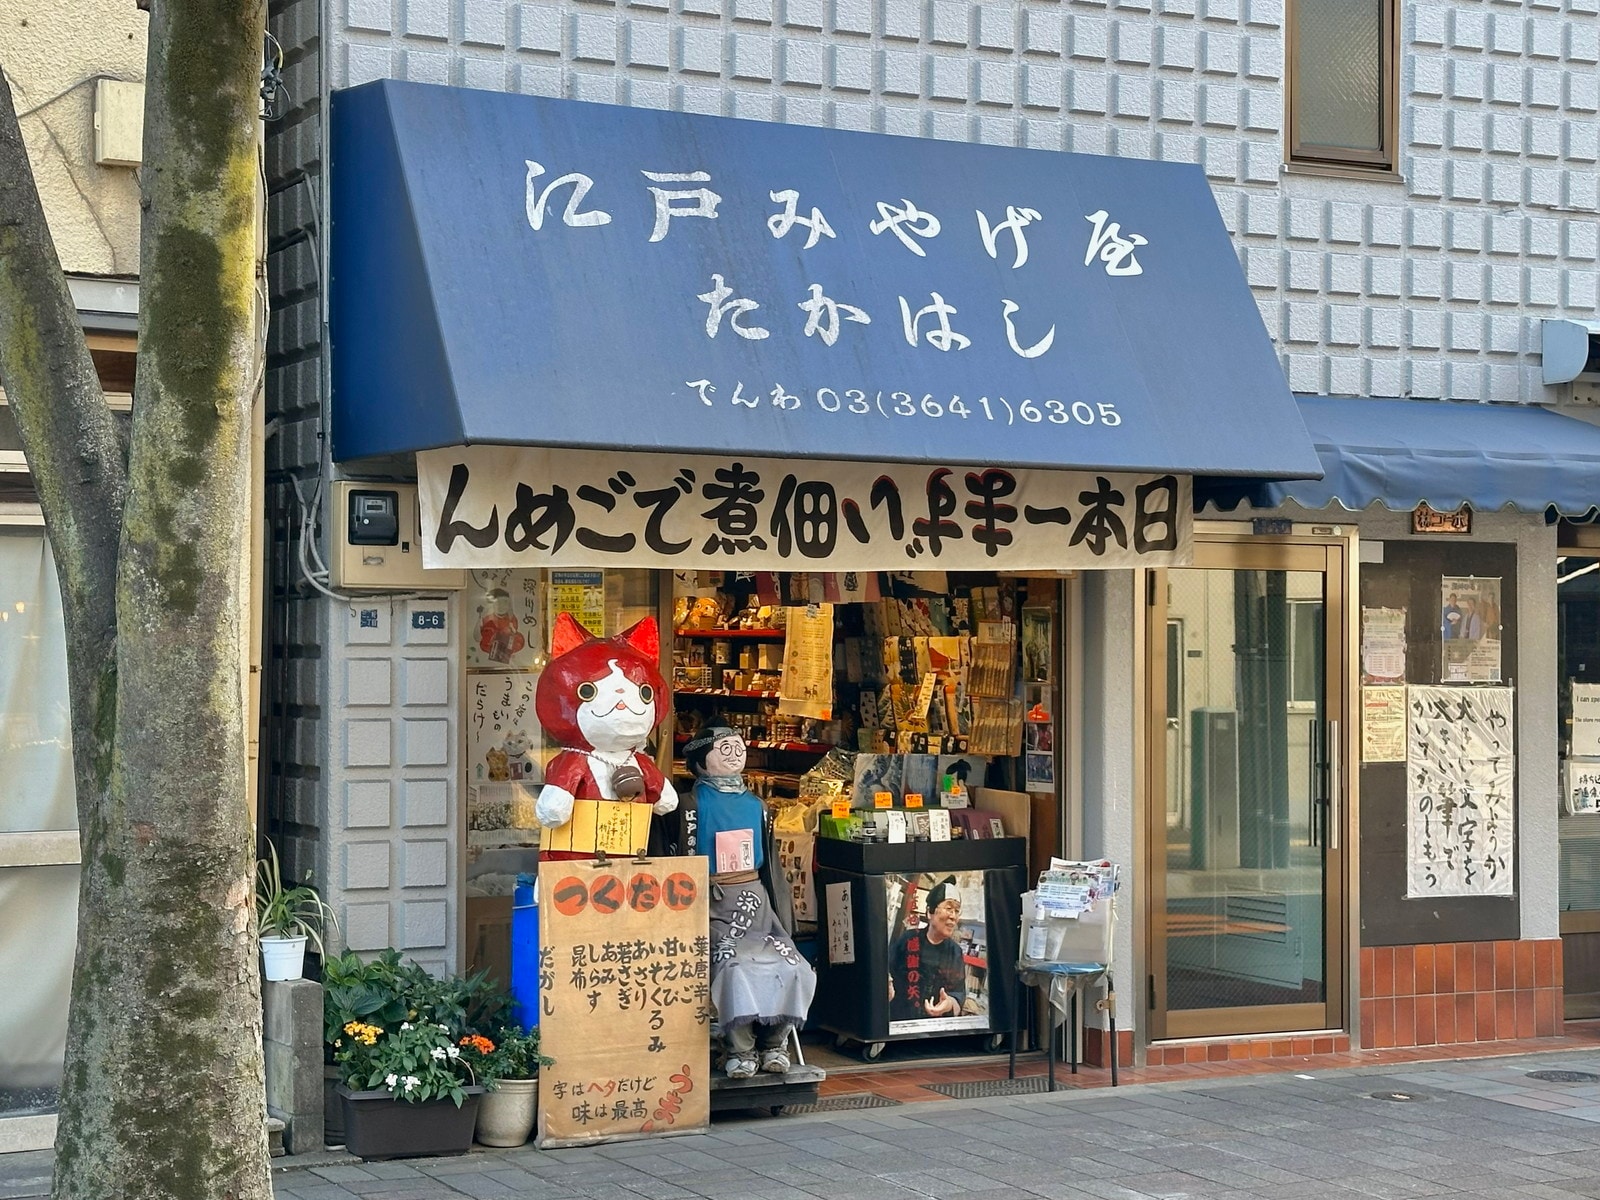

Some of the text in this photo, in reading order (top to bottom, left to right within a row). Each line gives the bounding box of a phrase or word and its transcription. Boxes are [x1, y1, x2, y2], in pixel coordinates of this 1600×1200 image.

[524, 159, 1147, 278] 江戸みやげ屋
[698, 273, 1056, 360] たかはし
[684, 378, 1123, 428] でんわ 03(3641)6305
[418, 615, 439, 626] 8-6
[553, 876, 694, 911] つくだに
[539, 944, 556, 1017] だがし
[569, 944, 588, 991] 昆布
[586, 943, 602, 1014] しらす
[600, 940, 617, 985] あみ
[616, 941, 633, 1010] 若さぎ
[632, 938, 650, 1011] あさり
[663, 936, 679, 1007] 甘えび
[679, 942, 695, 1004] いなご
[693, 935, 709, 1026] 葉唐辛子
[552, 1075, 658, 1100] 字はヘタだけど
[571, 1097, 648, 1126] 味は最高
